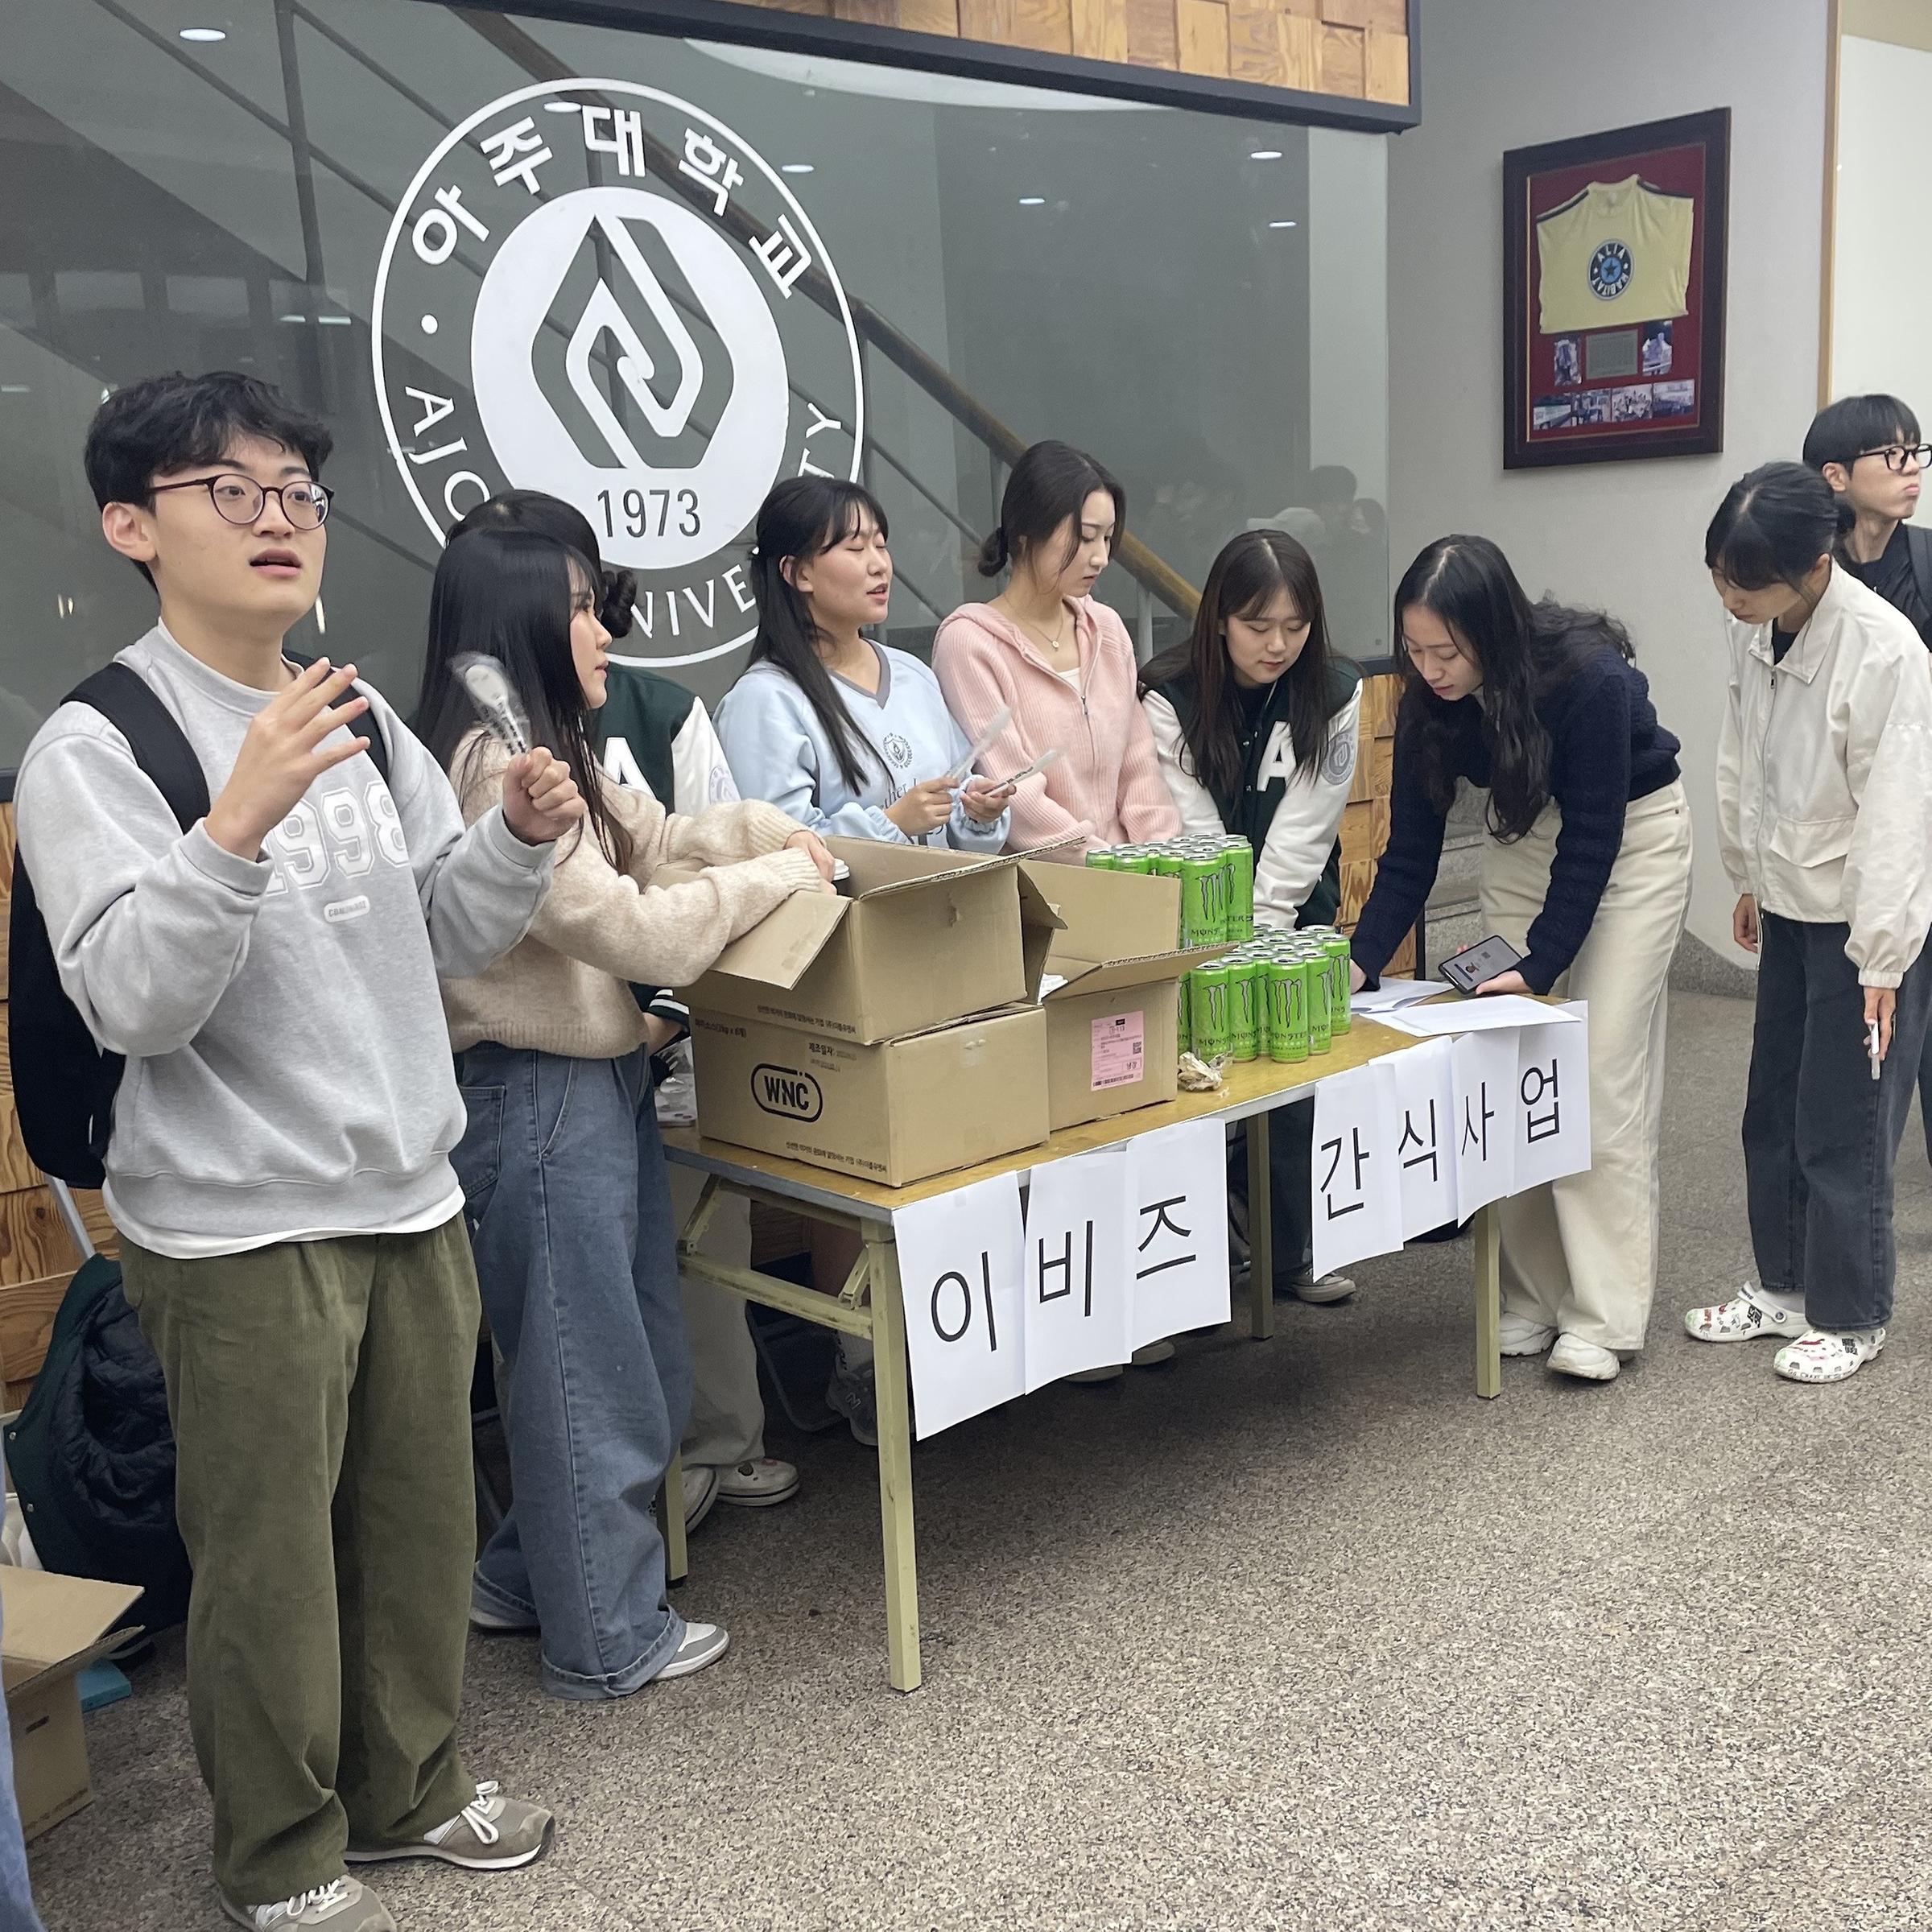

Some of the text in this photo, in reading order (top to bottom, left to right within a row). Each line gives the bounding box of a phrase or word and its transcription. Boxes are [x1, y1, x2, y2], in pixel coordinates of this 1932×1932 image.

[412, 105, 811, 299] 아주대학교
[405, 386, 491, 522] AJO
[597, 489, 701, 538] 1973
[1257, 720, 1297, 791] A
[764, 1075, 810, 1110] WNC
[931, 1059, 1562, 1352] 이비즈 간식사업
